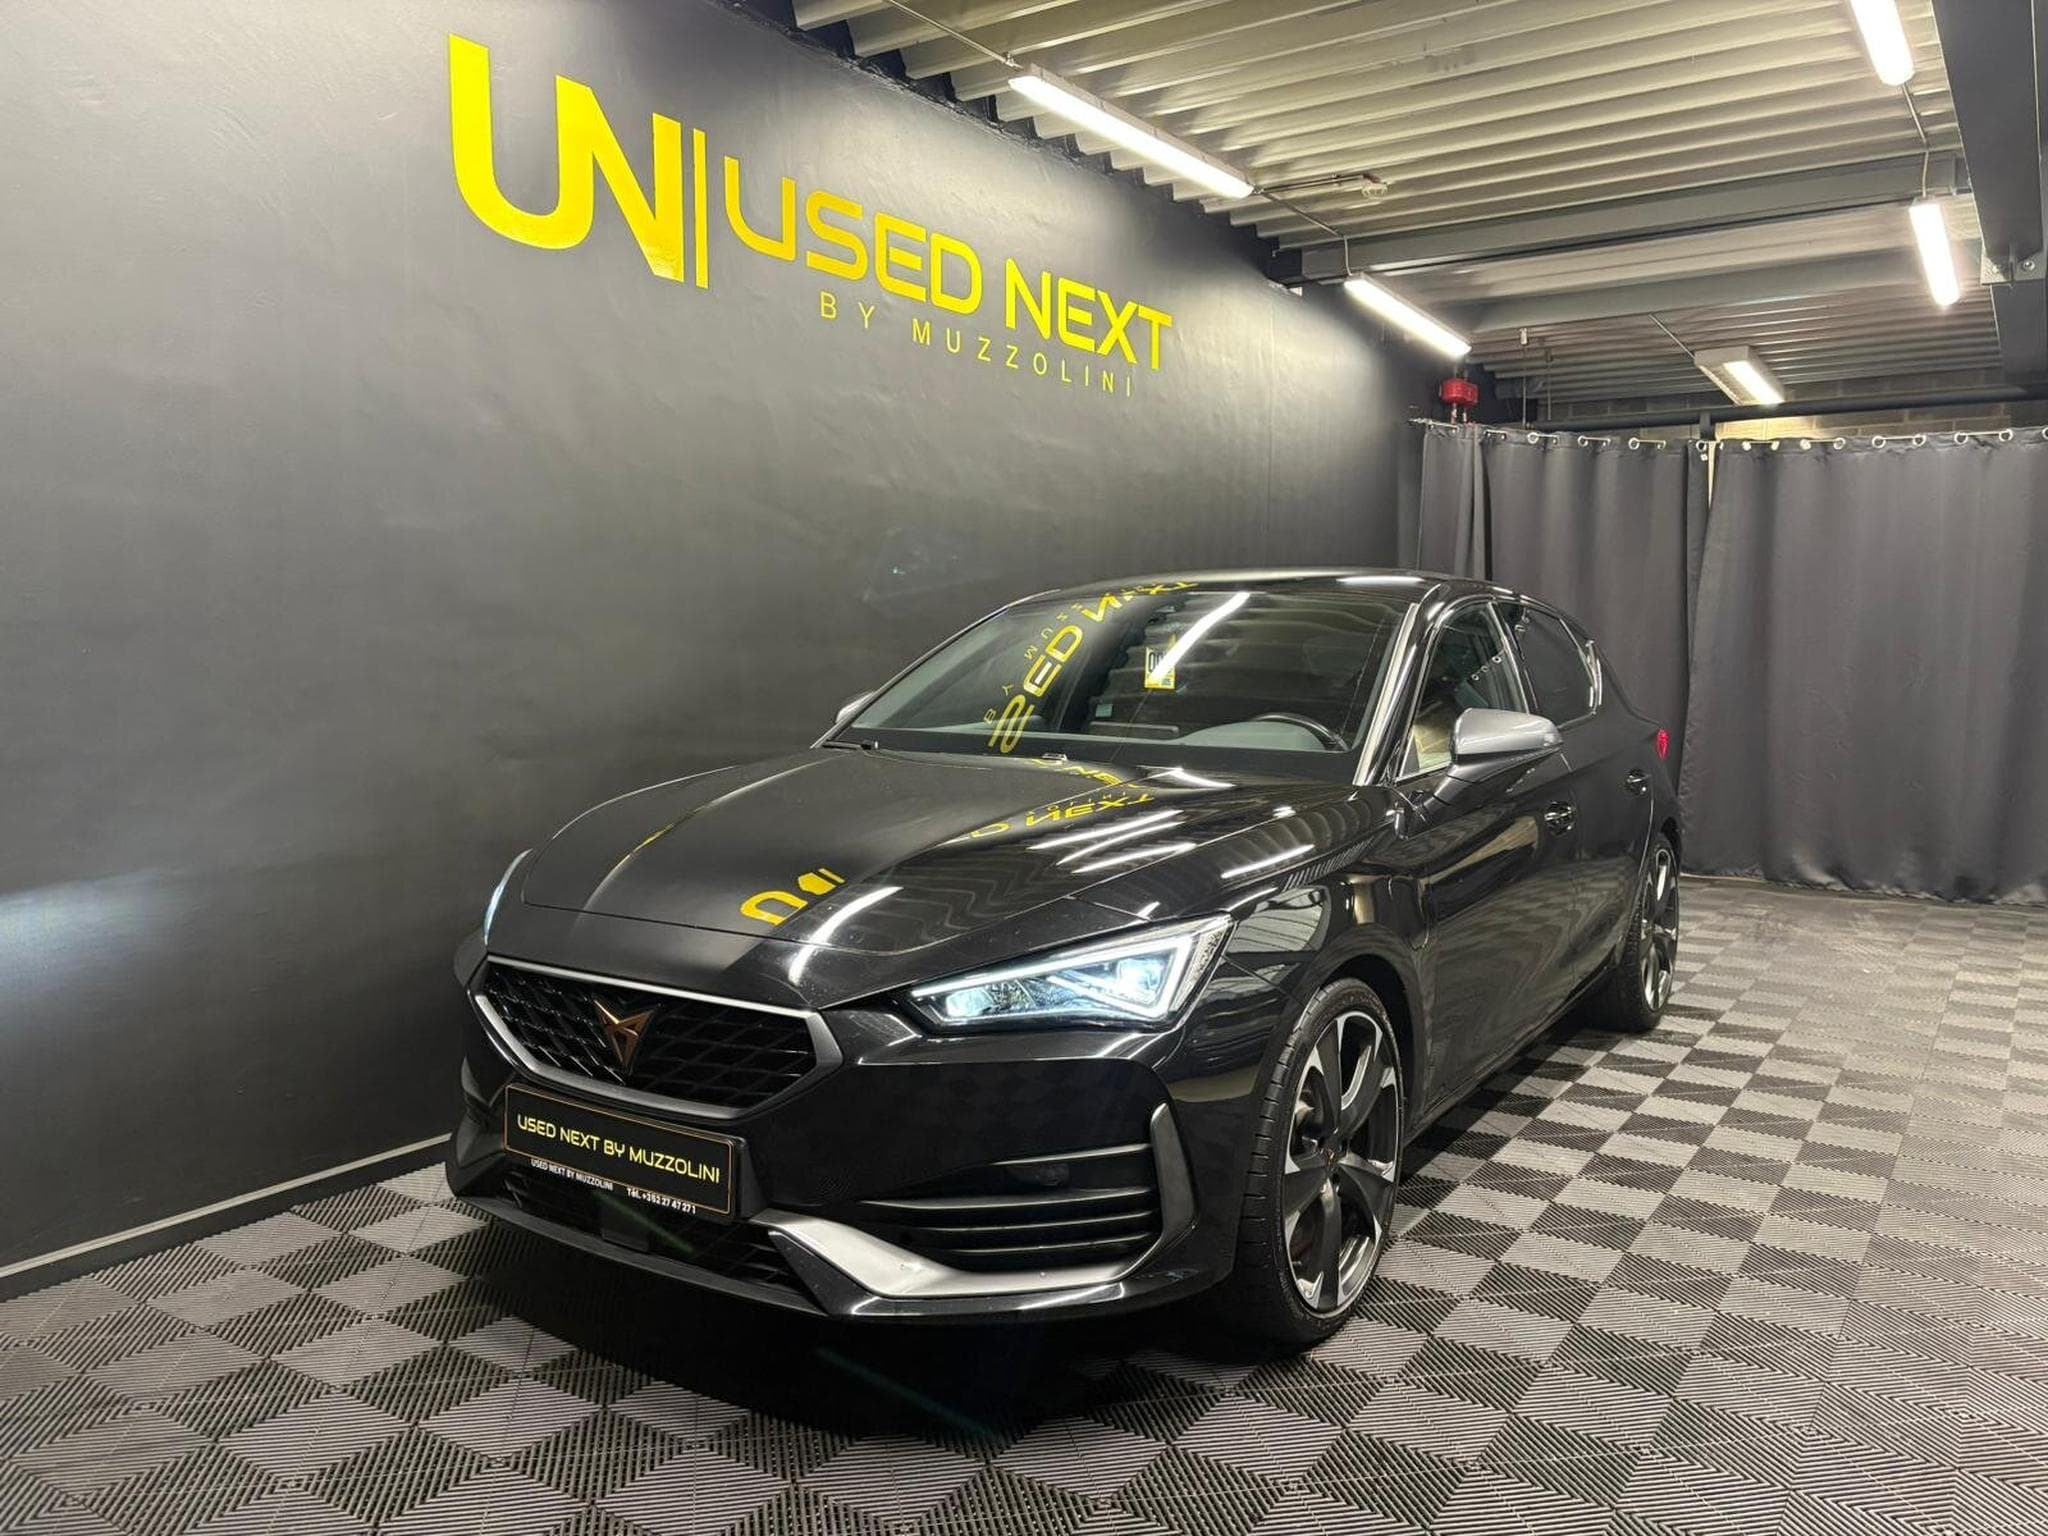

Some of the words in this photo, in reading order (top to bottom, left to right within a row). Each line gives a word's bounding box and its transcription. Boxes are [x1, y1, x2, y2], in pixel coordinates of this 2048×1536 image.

[724, 156, 983, 315] USED
[1005, 258, 1173, 372] NEXT
[820, 292, 875, 330] BY
[912, 317, 1134, 397] MUZZOLINI
[517, 1114, 556, 1139] USED
[560, 1127, 600, 1151] NEXT
[603, 1140, 625, 1158] BY
[629, 1146, 720, 1184] MUZZOLINI
[531, 1158, 548, 1171] USED
[549, 1163, 565, 1176] NEXT
[567, 1168, 575, 1179] BY
[576, 1170, 613, 1191] MUZZOLINI
